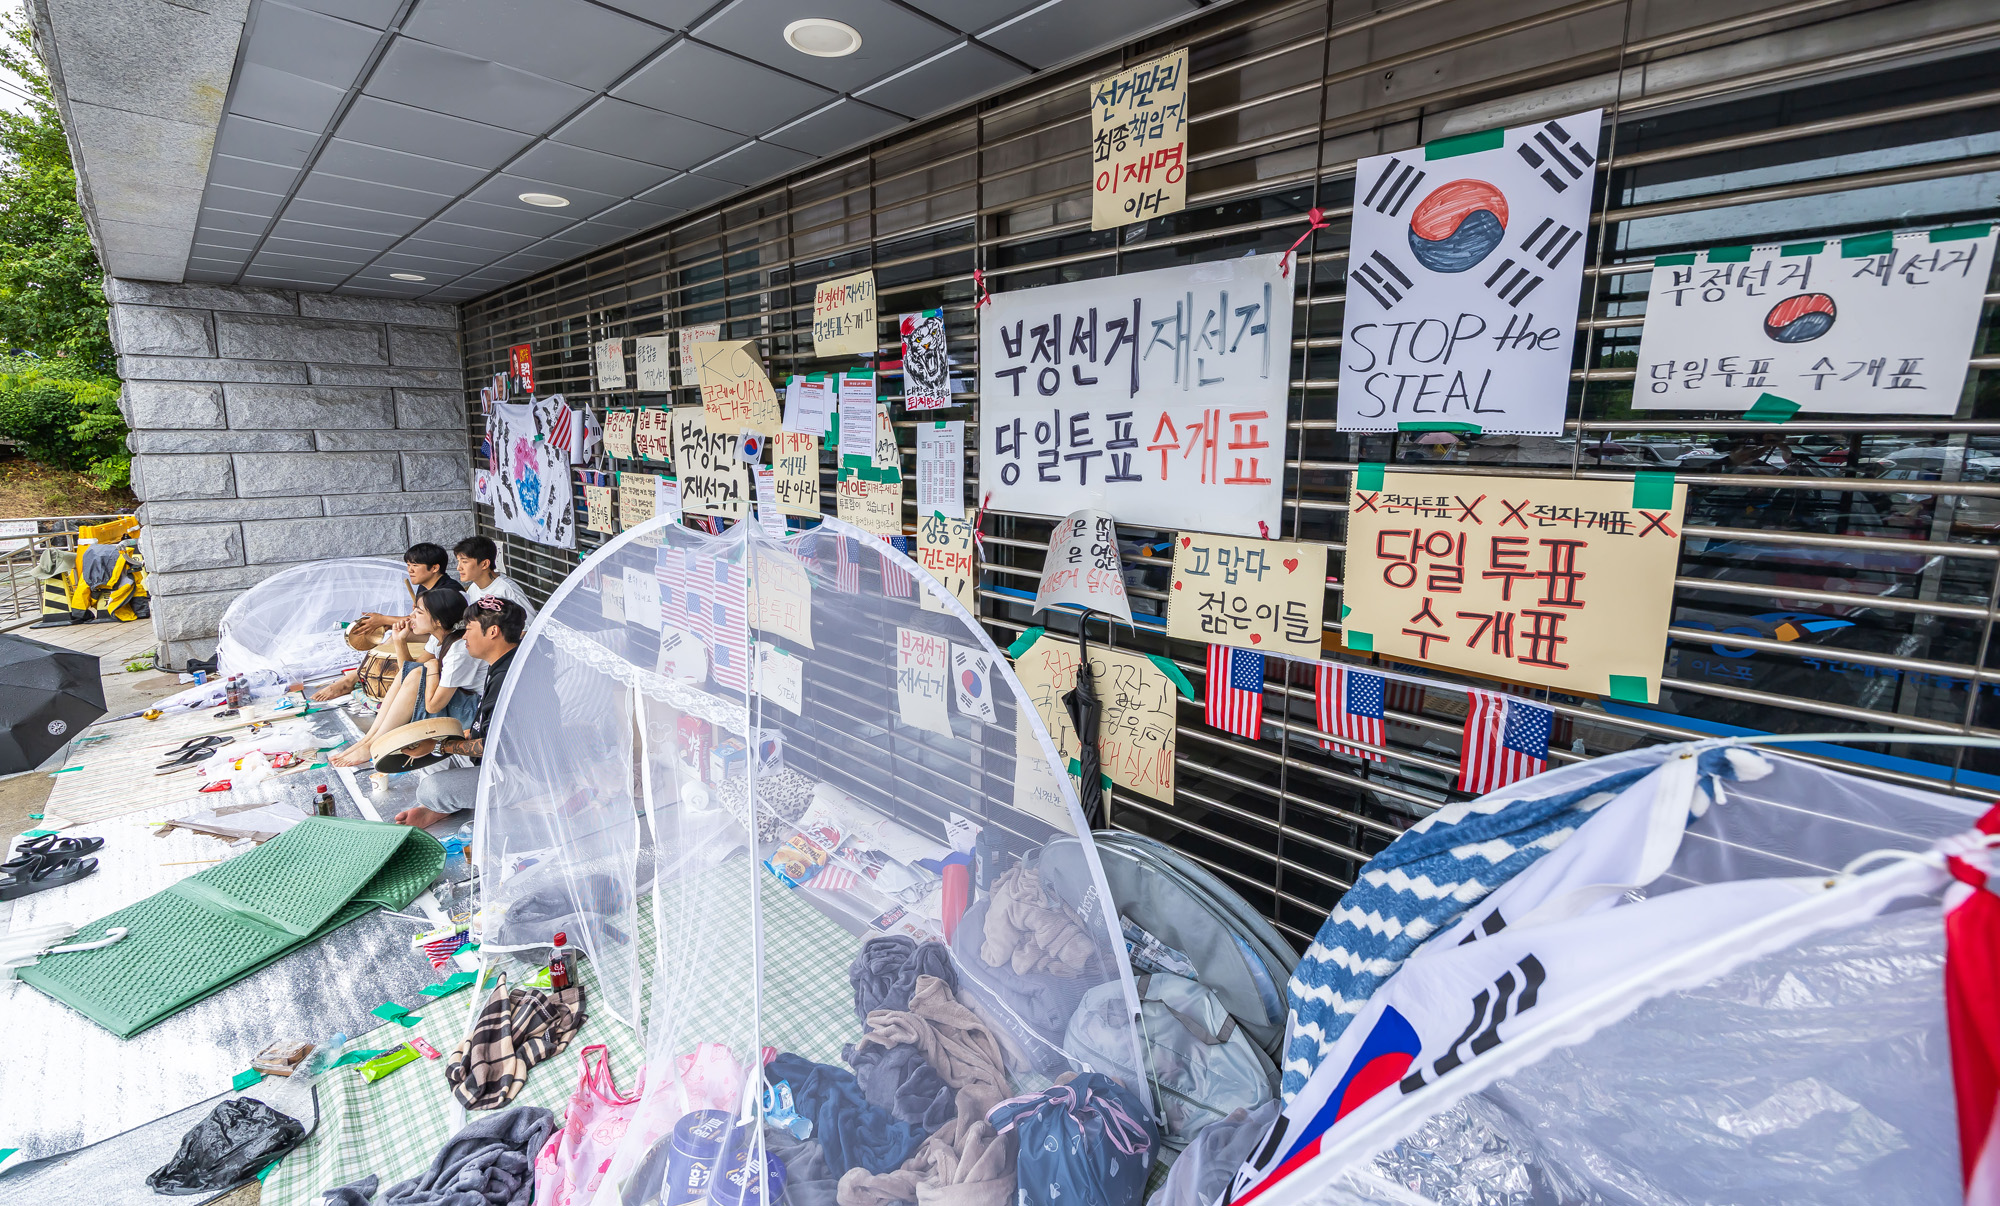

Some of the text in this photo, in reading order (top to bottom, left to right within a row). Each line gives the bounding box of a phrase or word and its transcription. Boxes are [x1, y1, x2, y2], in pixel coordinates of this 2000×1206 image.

[1096, 142, 1184, 193] 이재명
[1124, 188, 1170, 218] 이다
[1661, 243, 1978, 306] 부정선거 재선거
[817, 278, 875, 316] 부정선거 재선거
[815, 308, 873, 342] 당일투표 수개표
[995, 282, 1272, 398] 부정선거 재선거
[1348, 312, 1561, 373] STOP the
[737, 379, 766, 403] URA
[1357, 368, 1506, 418] STEAL
[1650, 356, 1927, 394] 당일투표 수개표
[654, 412, 668, 431] 투표
[774, 432, 813, 455] 이재명
[995, 409, 1143, 486] 당일투표
[1147, 409, 1272, 485] 수개표
[780, 455, 807, 476] 재판
[683, 475, 738, 512] 재선거
[839, 479, 899, 497] 게이트 지켜주세요
[840, 498, 894, 515] 투표함이 있습니다!
[1382, 493, 1634, 536] 전자투표 전자개표
[919, 547, 972, 577] 건드리지
[1185, 546, 1270, 585] 고맙다
[1376, 528, 1588, 609] 당일 투표
[1198, 591, 1322, 643] 젊은이들
[900, 631, 946, 669] 부정선거
[898, 667, 945, 702] 재선거
[687, 1168, 711, 1187] 홈키
